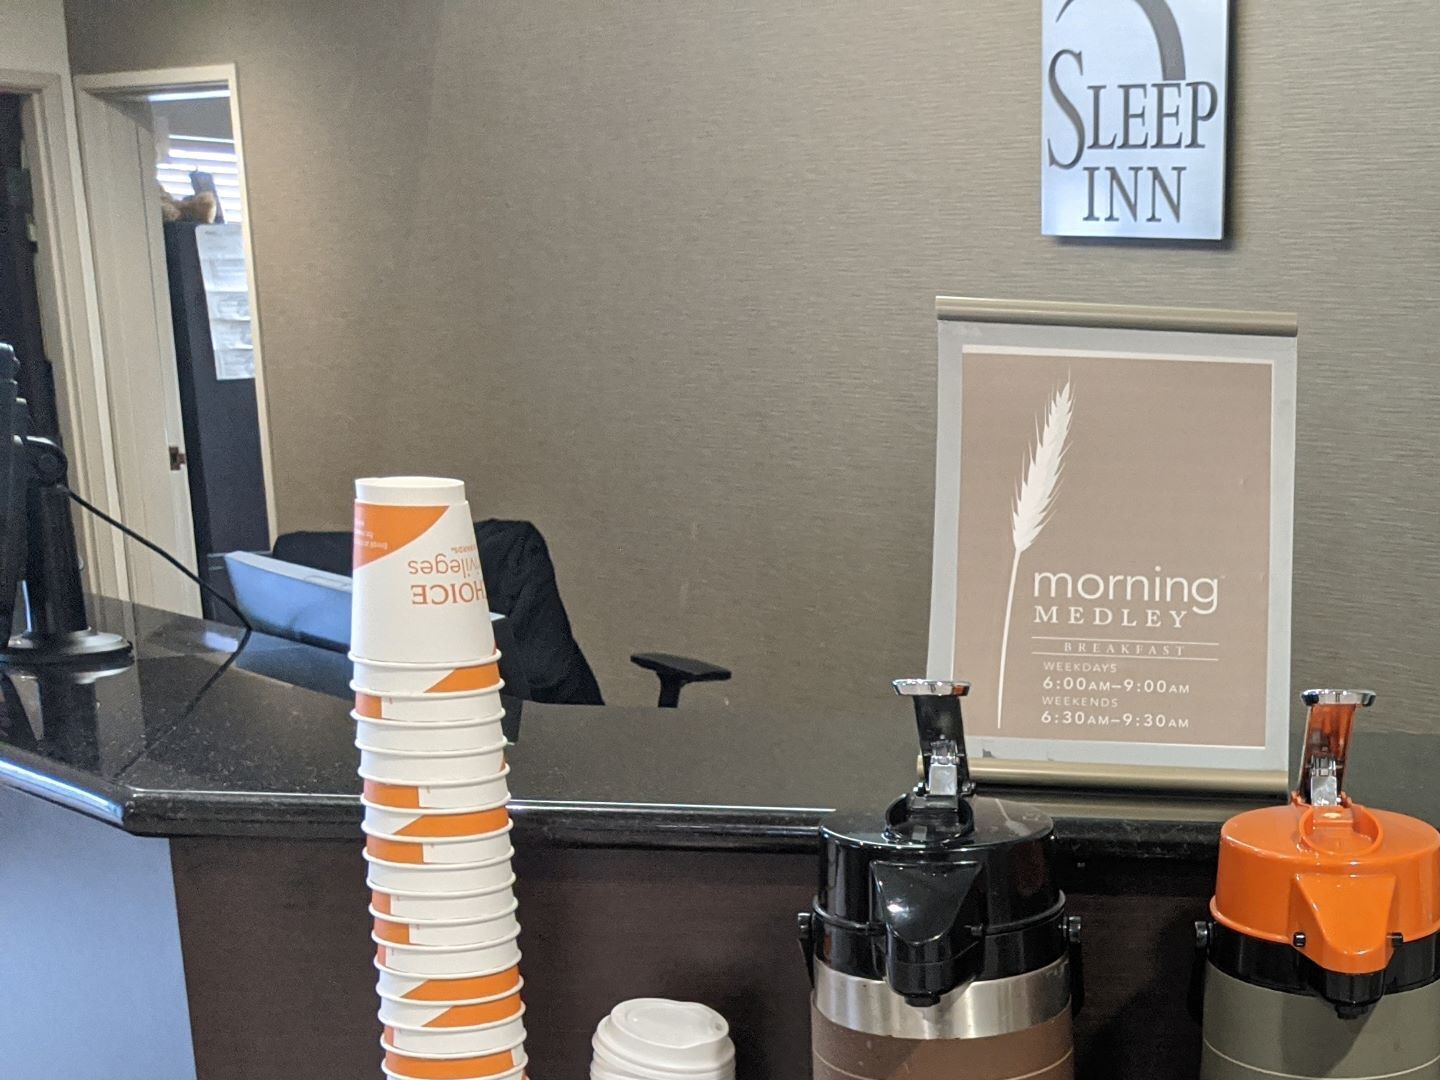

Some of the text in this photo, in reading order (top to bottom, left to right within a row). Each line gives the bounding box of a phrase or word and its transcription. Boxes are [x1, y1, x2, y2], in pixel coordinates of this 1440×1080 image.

[1047, 48, 1218, 170] SLEEP
[1082, 166, 1187, 223] INN
[410, 580, 486, 605] HOICE
[1033, 565, 1219, 615] morning
[1033, 605, 1187, 628] MEDLEY
[1063, 641, 1186, 657] BREAKFAST
[1043, 661, 1118, 673] WEEKDAYS
[1041, 695, 1119, 708] WEEKENDS
